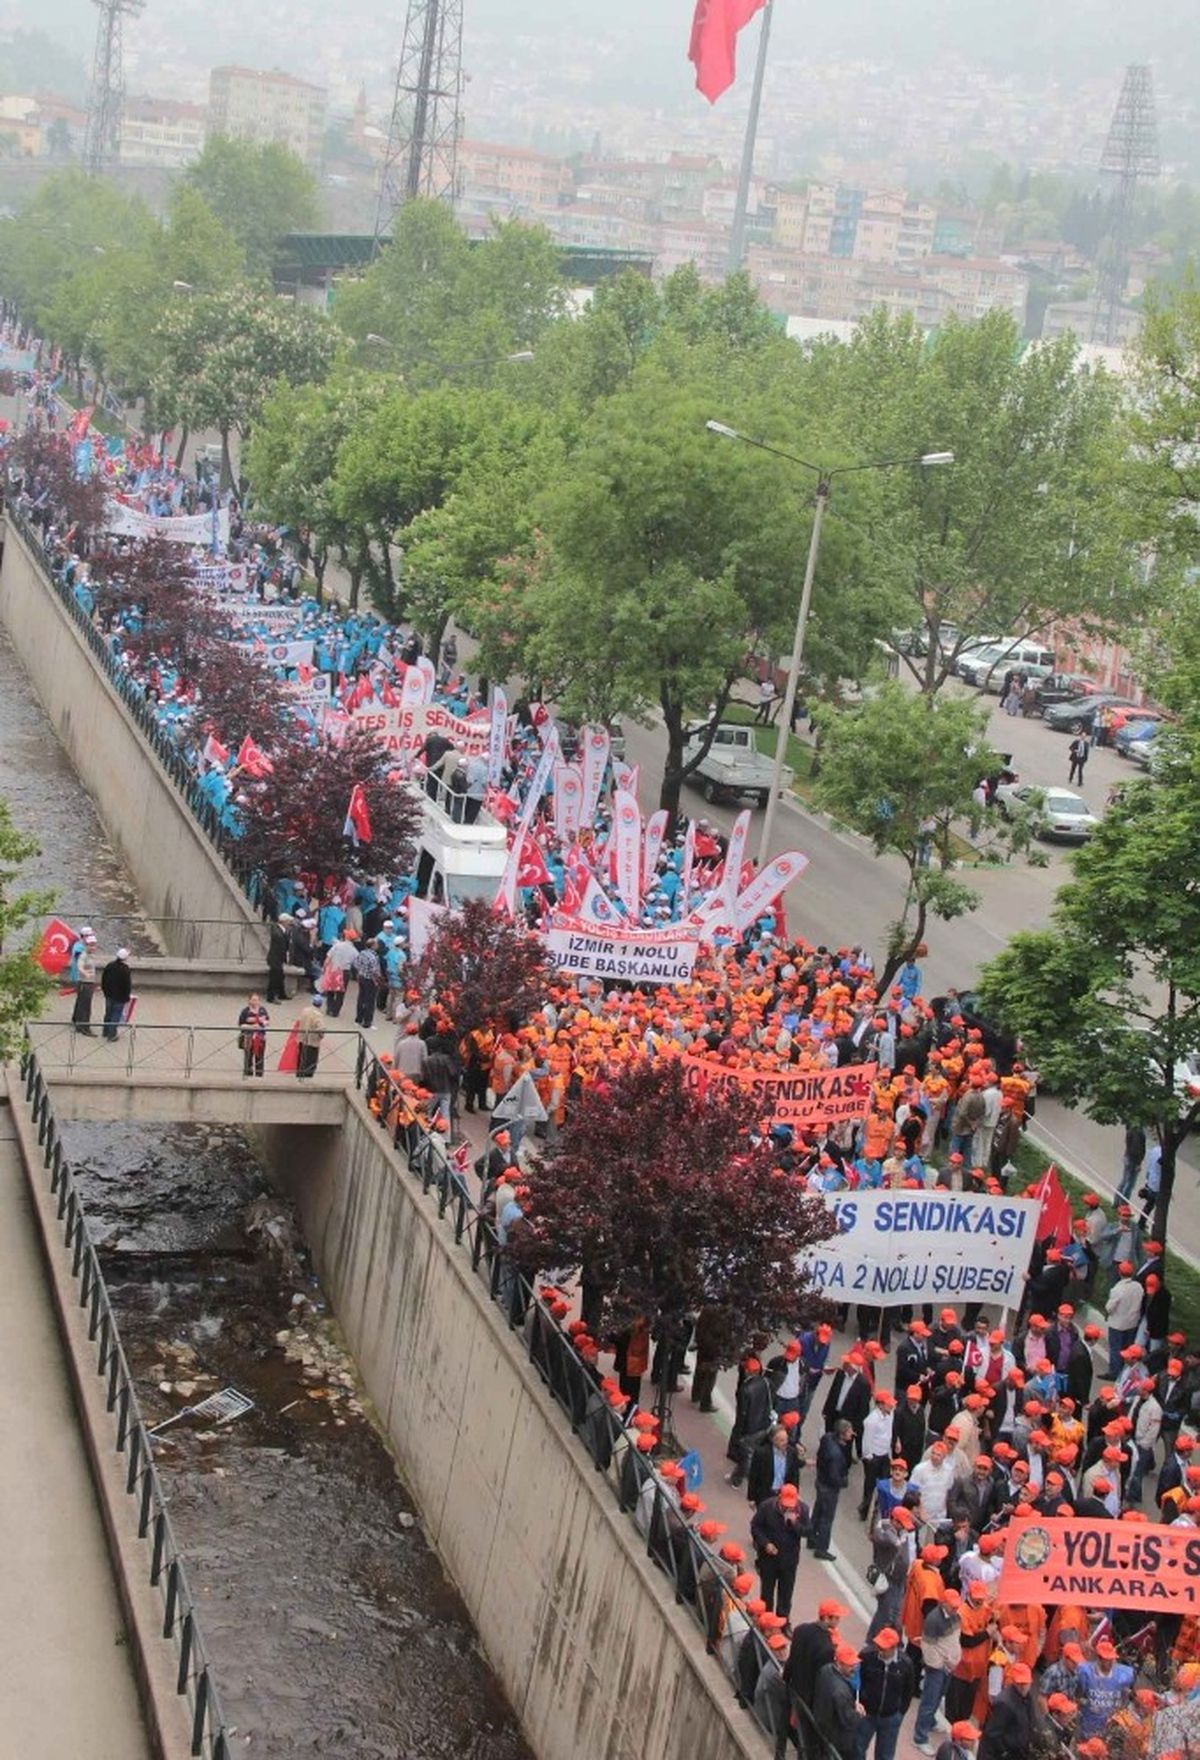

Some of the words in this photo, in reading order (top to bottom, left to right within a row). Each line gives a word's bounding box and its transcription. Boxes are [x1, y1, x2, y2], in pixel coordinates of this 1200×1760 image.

[568, 933, 615, 955] İZMİR
[620, 945, 628, 956] 1
[633, 946, 679, 960] NOLU
[873, 1198, 1027, 1239] SENDİKASI
[852, 1263, 868, 1290] 2
[871, 1265, 928, 1294] NOLU
[931, 1264, 1015, 1295] ŞUBESİ
